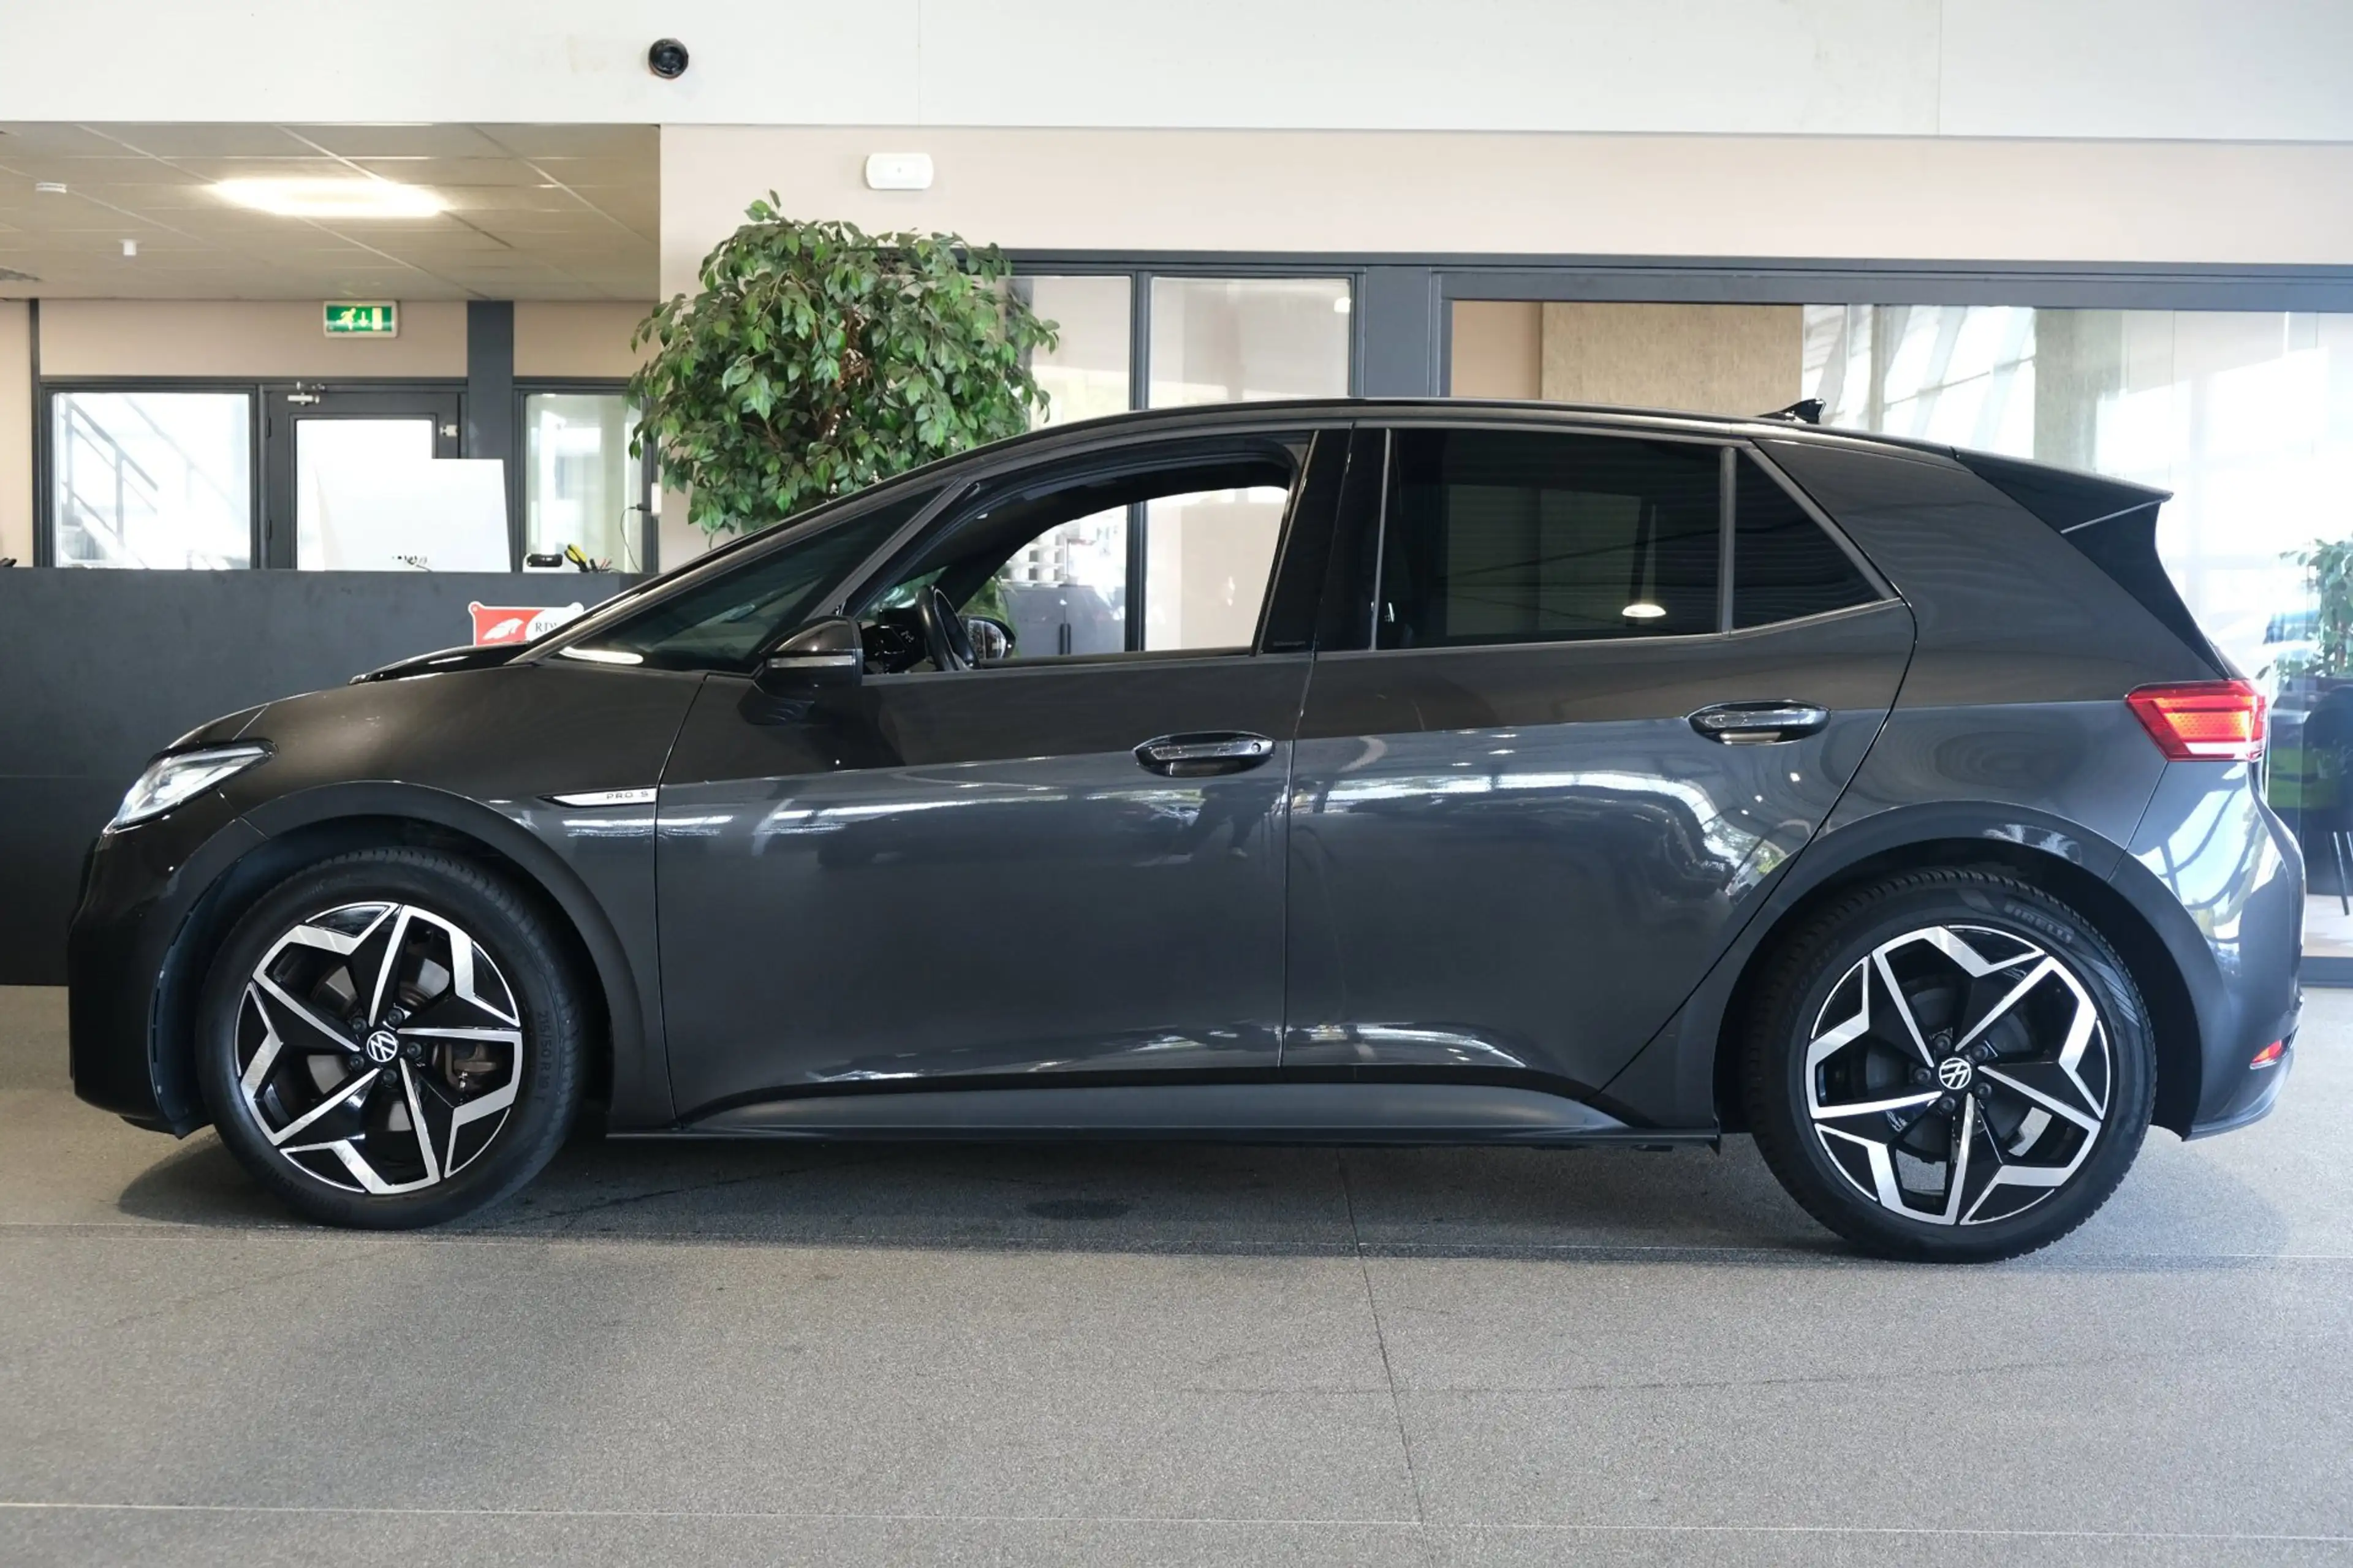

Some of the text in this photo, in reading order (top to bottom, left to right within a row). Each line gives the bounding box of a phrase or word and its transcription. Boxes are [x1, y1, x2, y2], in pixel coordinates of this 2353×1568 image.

[536, 622, 557, 632] RD
[537, 1010, 553, 1058] 215/50
[539, 1061, 552, 1071] R
